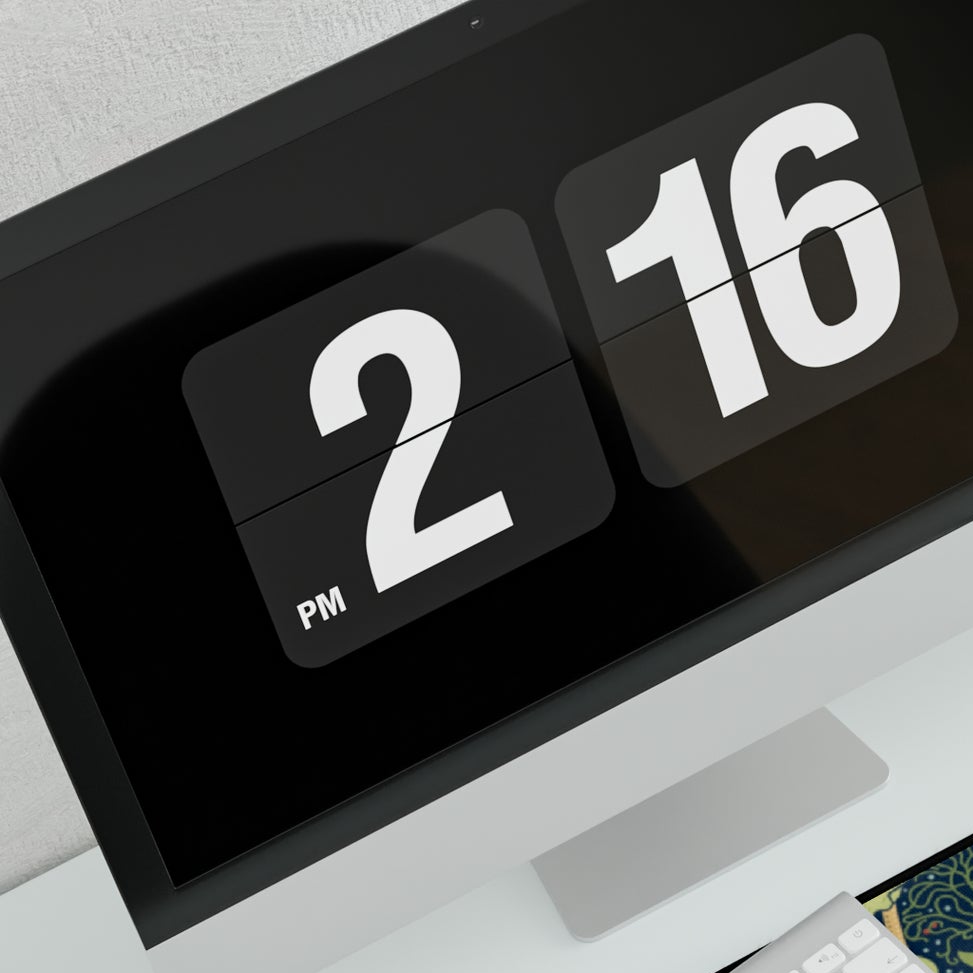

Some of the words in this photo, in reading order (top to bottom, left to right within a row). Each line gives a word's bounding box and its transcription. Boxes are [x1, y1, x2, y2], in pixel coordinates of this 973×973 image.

[606, 103, 900, 417] 16
[310, 309, 514, 593] 2
[297, 586, 346, 630] PM
